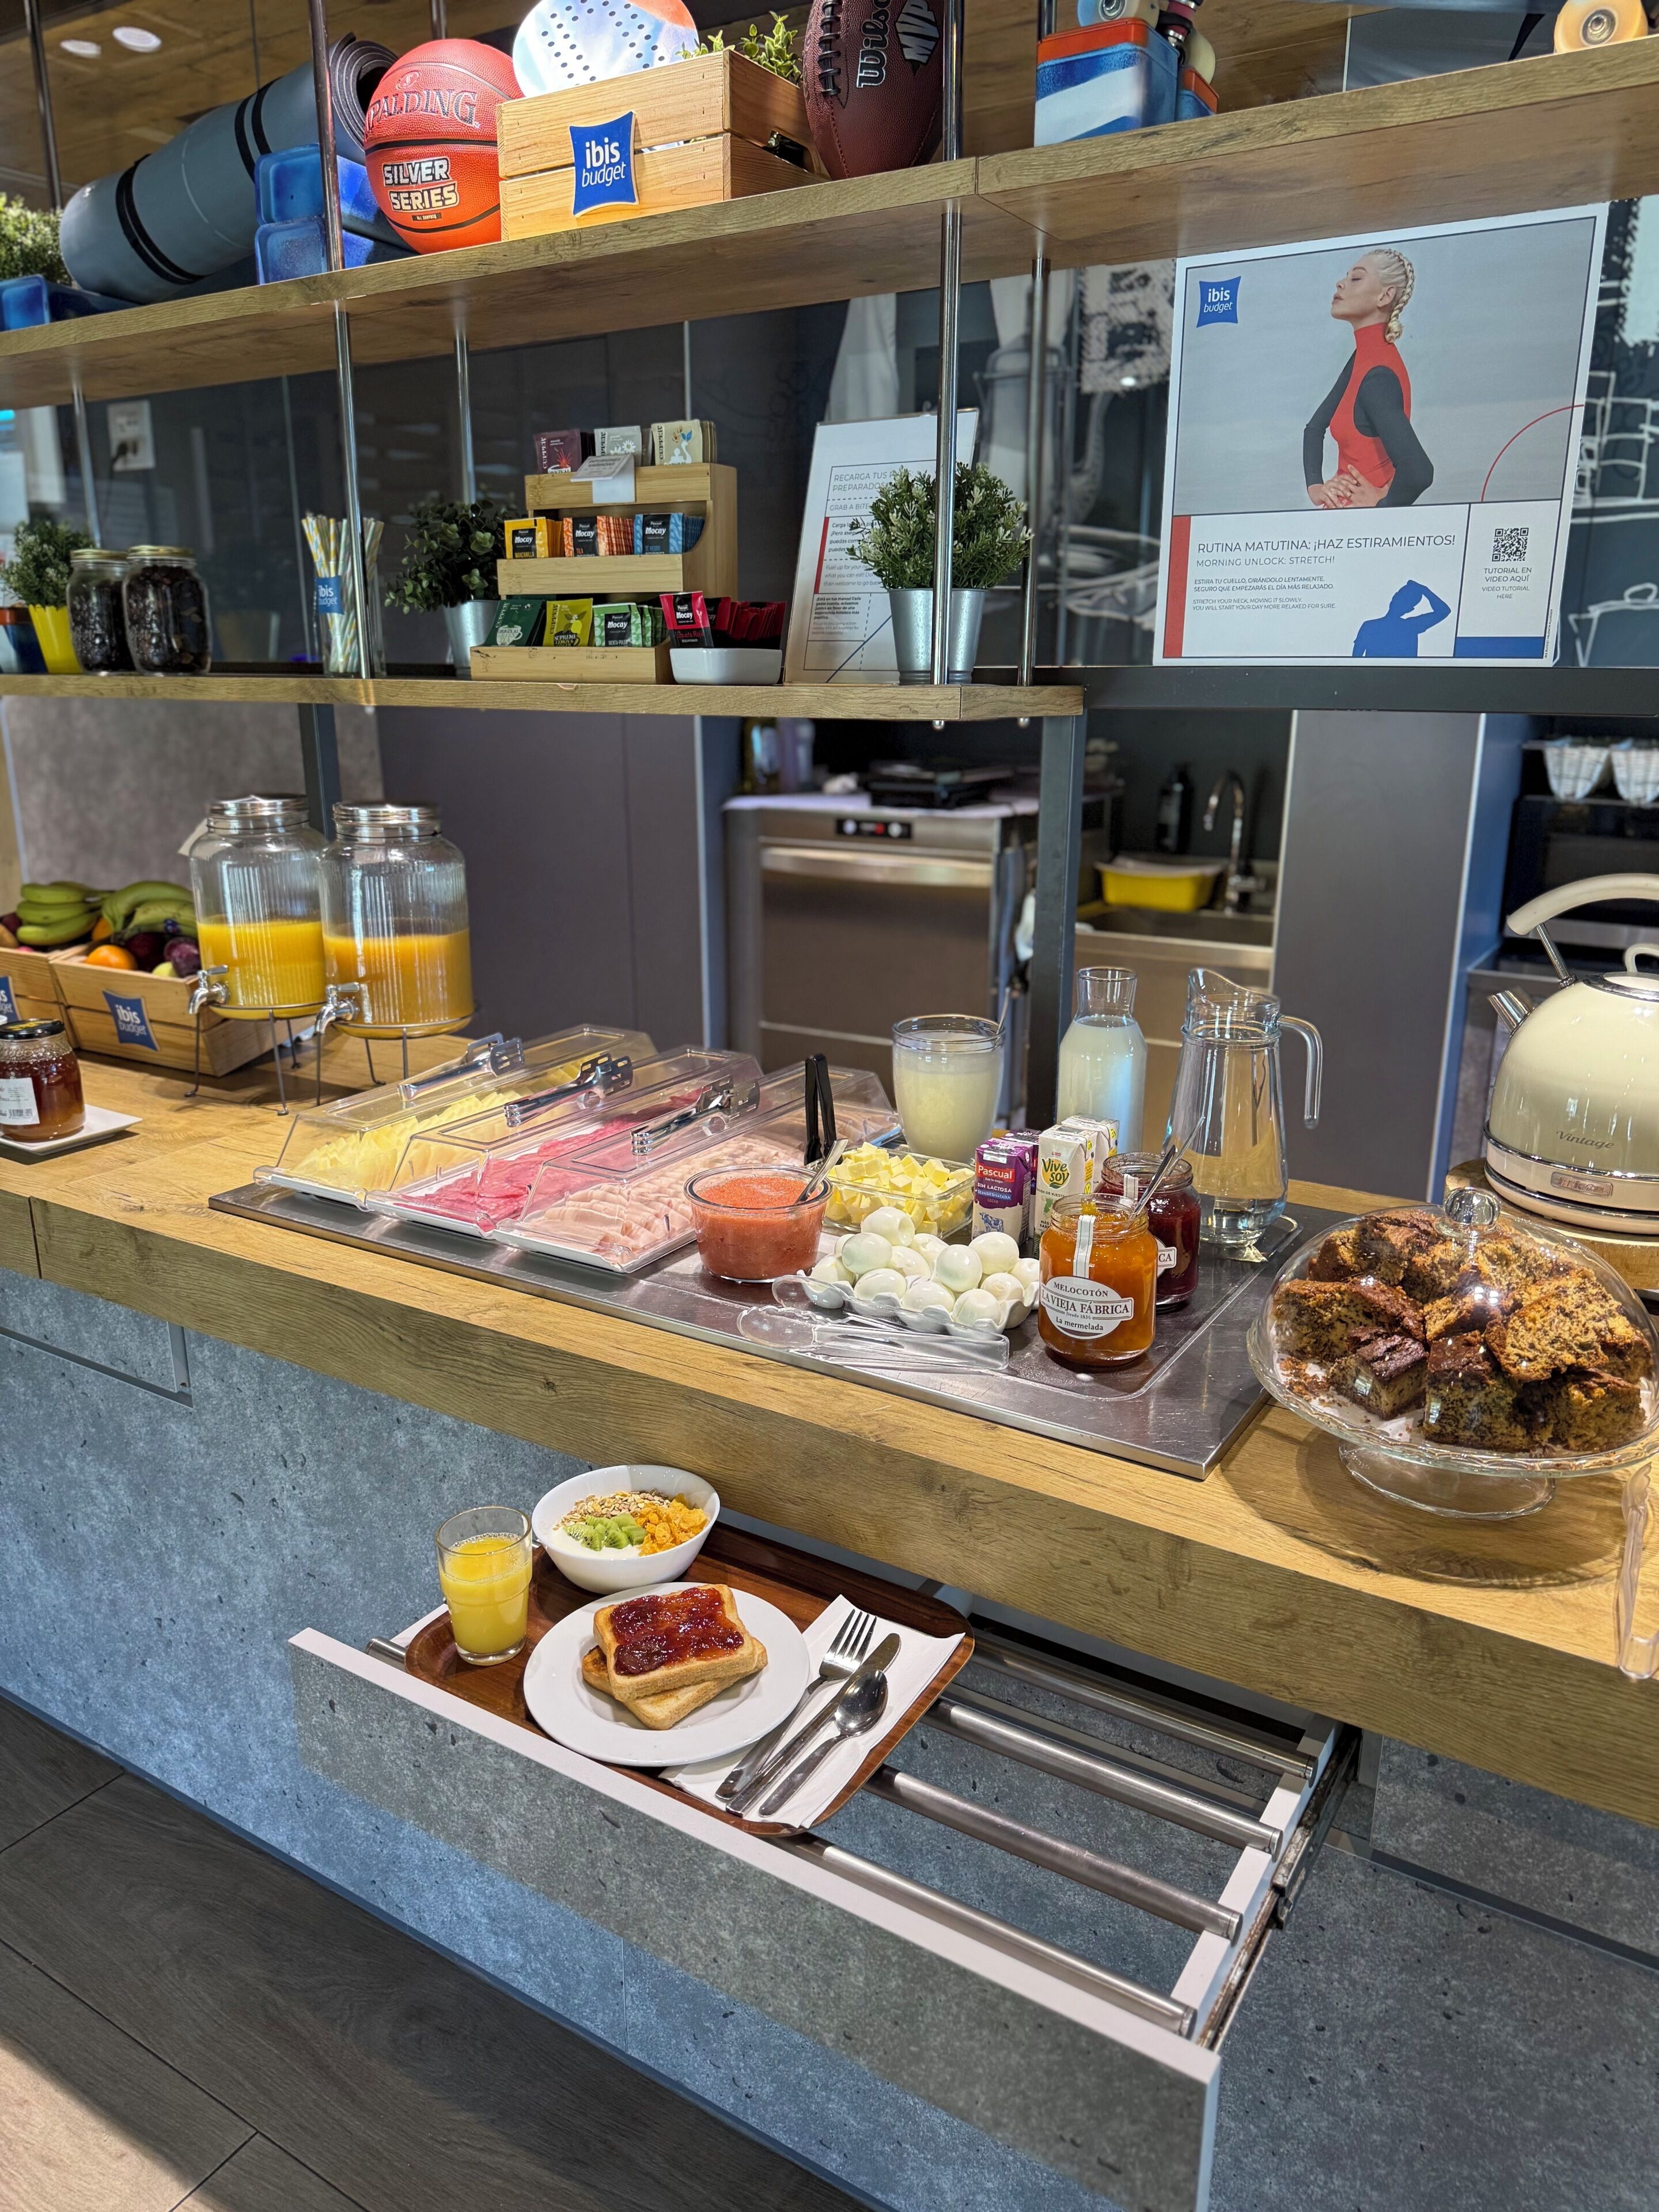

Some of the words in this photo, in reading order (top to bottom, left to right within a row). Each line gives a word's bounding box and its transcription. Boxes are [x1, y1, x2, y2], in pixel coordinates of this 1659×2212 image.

[366, 89, 477, 138] PALDING
[585, 137, 620, 169] ibis
[384, 159, 449, 185] SILVER
[582, 161, 626, 187] budget
[390, 184, 458, 210] SERIES
[1208, 287, 1230, 302] ibis
[1203, 302, 1233, 313] budget
[834, 473, 870, 482] RECARGA
[575, 530, 594, 538] Mocay
[645, 527, 666, 536] Mocay
[1198, 542, 1241, 553] RUTINA
[1245, 540, 1310, 552] MATUTINA:
[1314, 539, 1343, 551] ¡HAZ
[1347, 535, 1455, 548] ESTIRAMIENTOS!
[1196, 559, 1241, 567] MORNING
[1245, 557, 1286, 566] UNLOCK:
[1289, 556, 1335, 565] STRETCH!
[319, 585, 334, 597] ibis
[115, 1004, 141, 1024] ibis
[119, 1021, 147, 1036] budget
[1556, 1131, 1614, 1149] Vintage
[978, 1165, 1012, 1180] Pascual
[1041, 1158, 1067, 1173] Vive
[1049, 1172, 1070, 1185] soy
[978, 1190, 1011, 1199] SEMIDESNATADA
[987, 1185, 1012, 1193] LACTOSA
[1054, 1282, 1109, 1297] MELOCOTÓN
[1041, 1289, 1050, 1302] LA
[1050, 1294, 1078, 1312] VIEJA
[1080, 1302, 1130, 1315] FÁBRICA
[1065, 1320, 1104, 1331] mermelada
